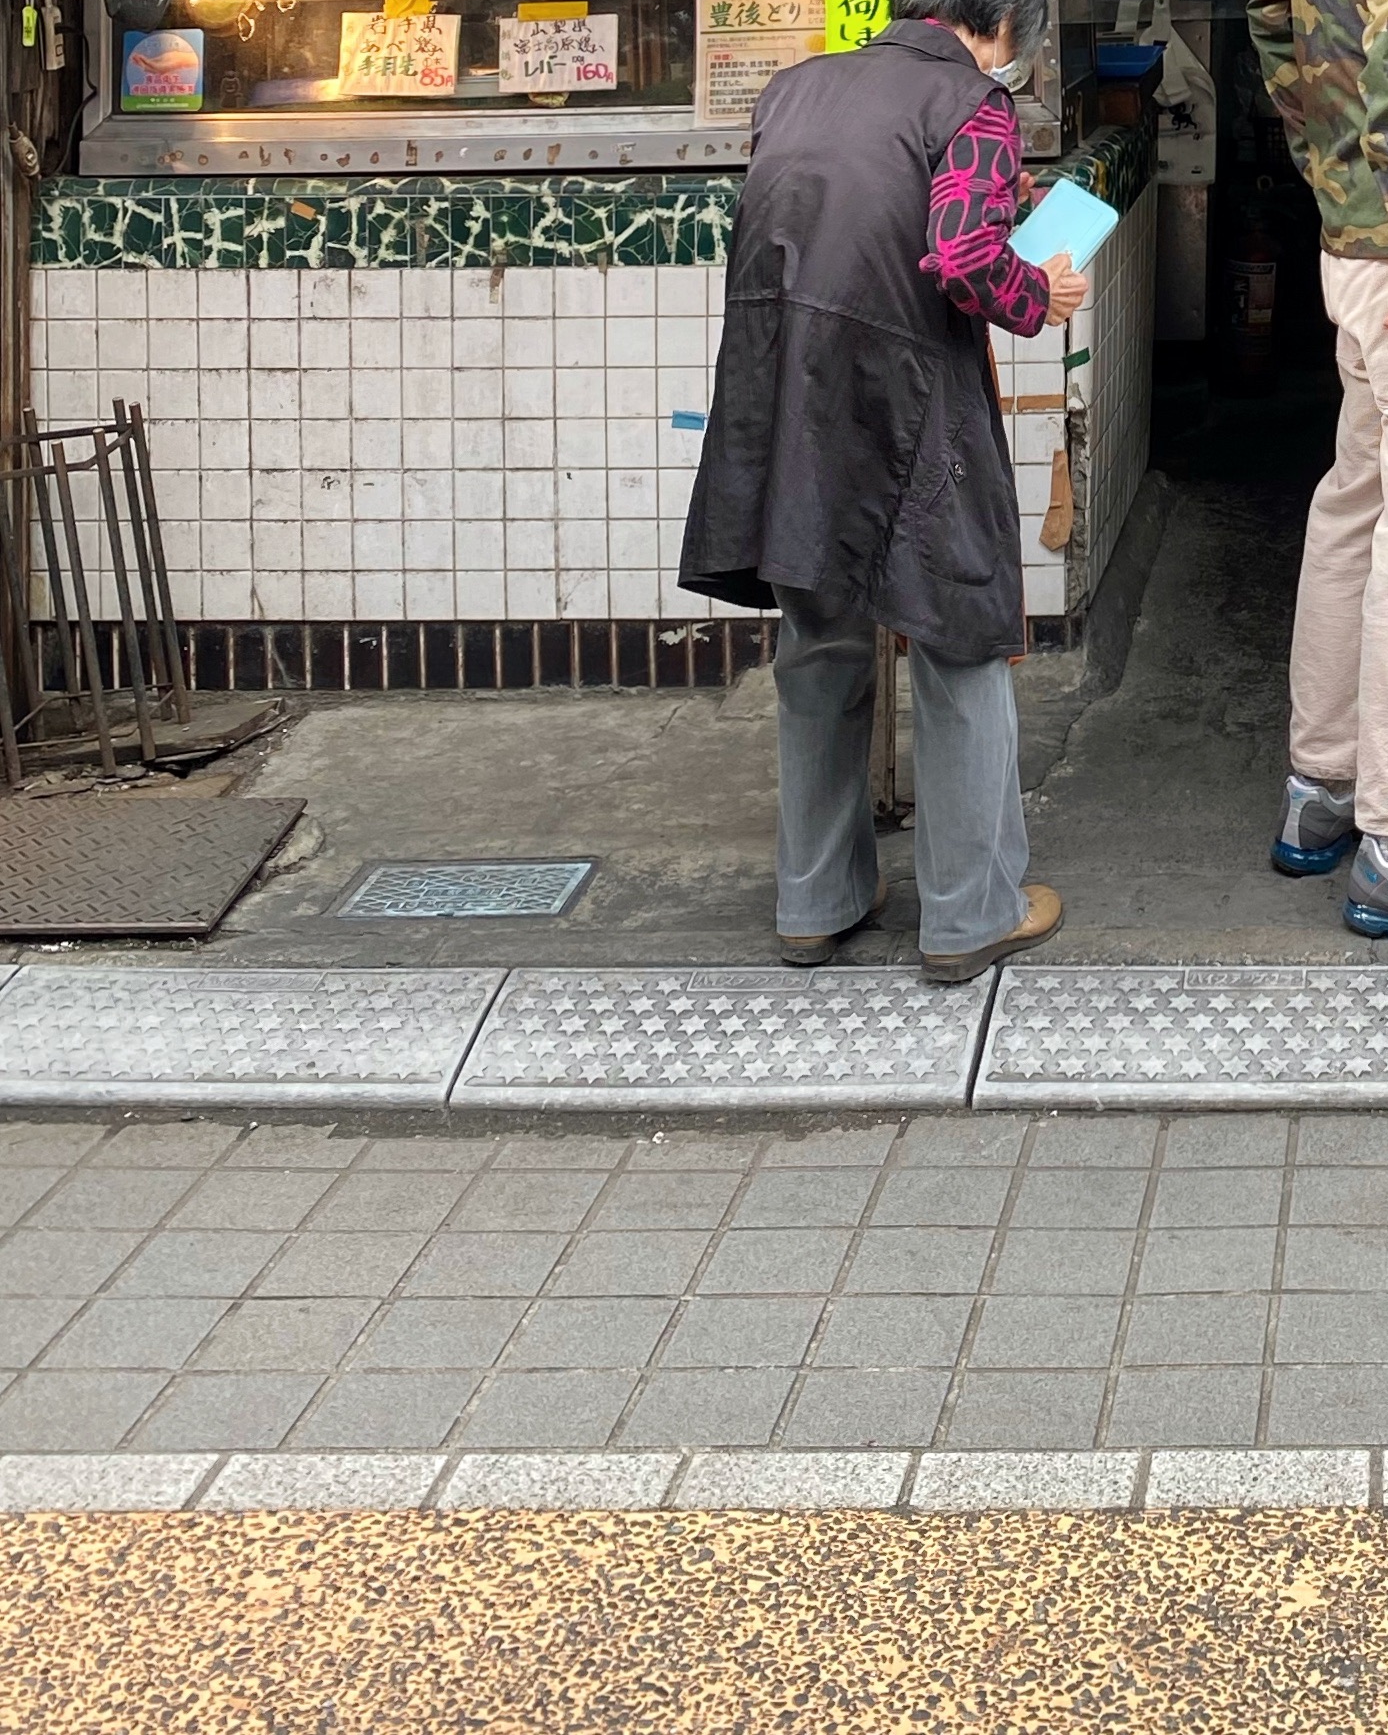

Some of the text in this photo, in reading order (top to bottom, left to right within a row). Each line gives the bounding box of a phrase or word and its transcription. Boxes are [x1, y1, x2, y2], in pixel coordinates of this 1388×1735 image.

[366, 14, 443, 35] 岩手県
[708, 0, 802, 29] 豊後どり
[357, 52, 419, 77] 手羽先
[523, 54, 567, 78] レバー
[576, 63, 614, 84] 160円
[419, 66, 454, 88] 85円
